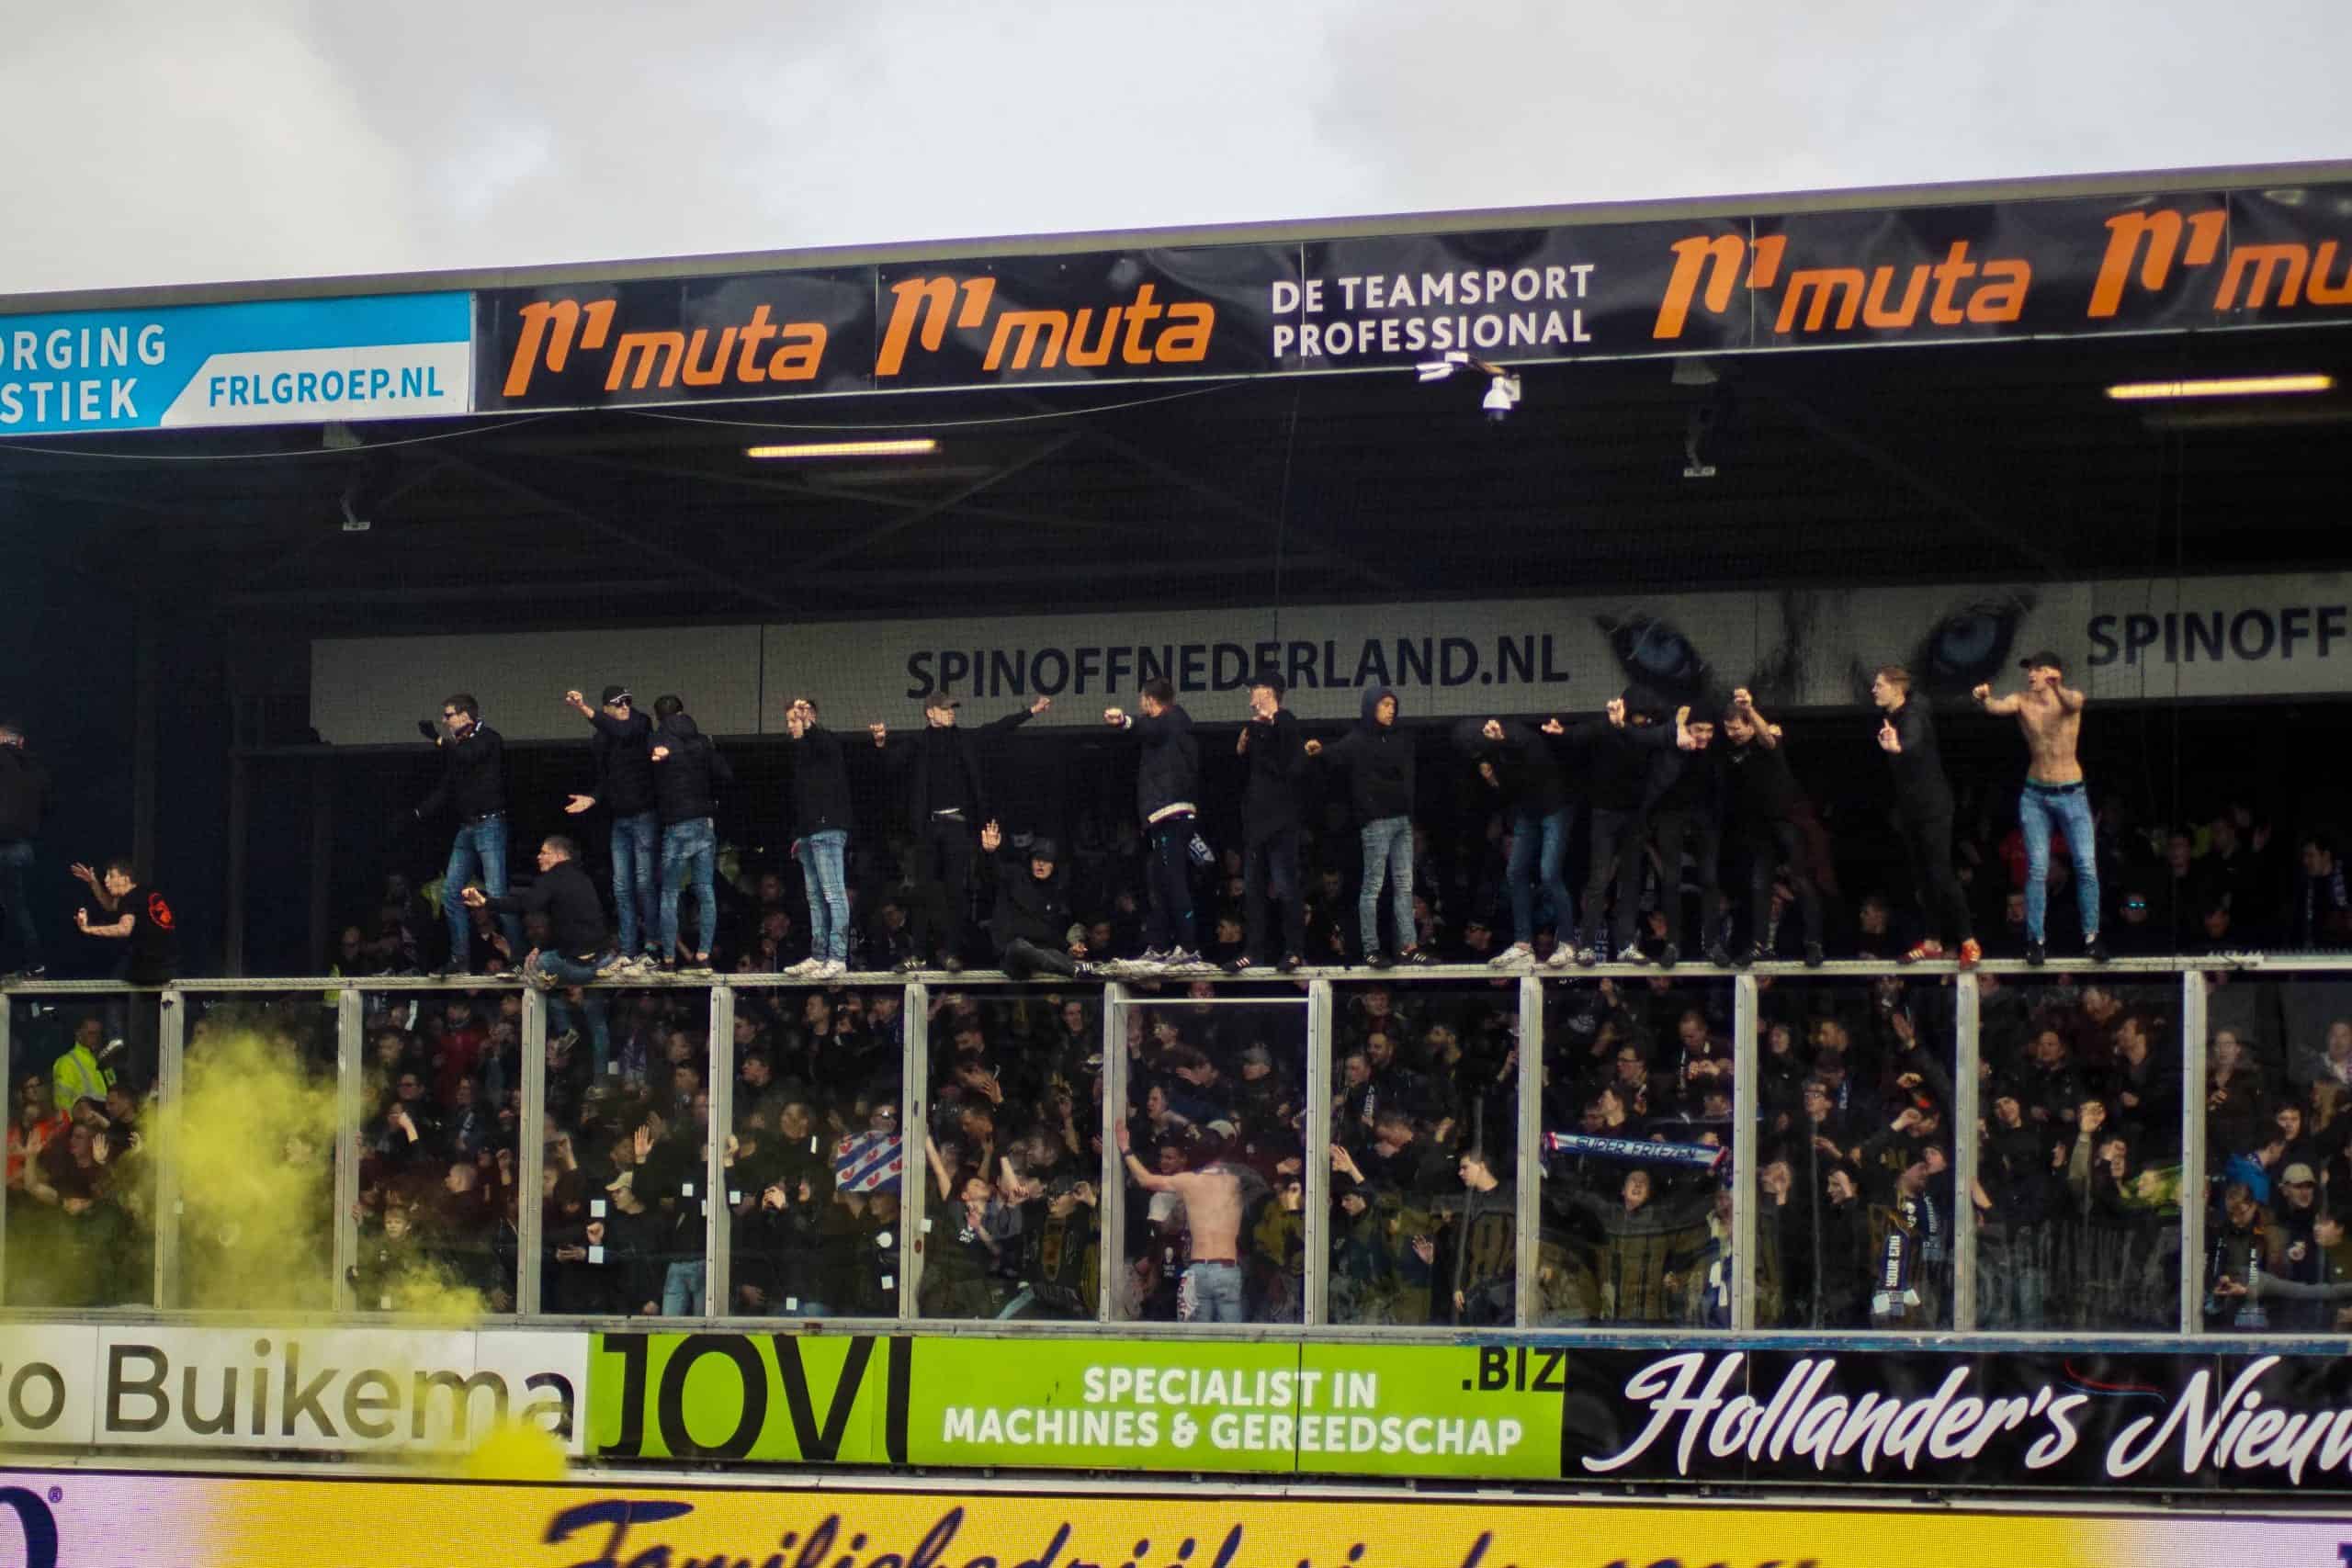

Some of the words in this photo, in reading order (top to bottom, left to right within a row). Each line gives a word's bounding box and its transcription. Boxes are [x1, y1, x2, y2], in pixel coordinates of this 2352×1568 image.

[1272, 279, 1324, 314] DE
[1338, 264, 1595, 310] TEAMSPORT
[1775, 241, 2031, 333] muta
[0, 324, 165, 370] RGING
[605, 304, 828, 390] muta
[983, 284, 1216, 371] muta
[1273, 309, 1591, 357] PROFESSIONAL
[209, 367, 444, 408] FRLGROEP.NL
[907, 634, 1569, 700] SPINOFFNEDERLAND.NL
[2086, 604, 2348, 667] SPINOFF
[0, 1361, 66, 1430] o
[105, 1338, 575, 1443] Buikema
[597, 1334, 912, 1463] JOVI
[1083, 1366, 1322, 1408] SPECIALIST
[1333, 1371, 1376, 1409] IN
[1462, 1347, 1566, 1393] .BIZ
[943, 1406, 1159, 1447] MACHINES
[1170, 1411, 1199, 1449] &
[1210, 1412, 1522, 1456] GEREEDSCHAP
[1582, 1351, 2088, 1475] Hollander's
